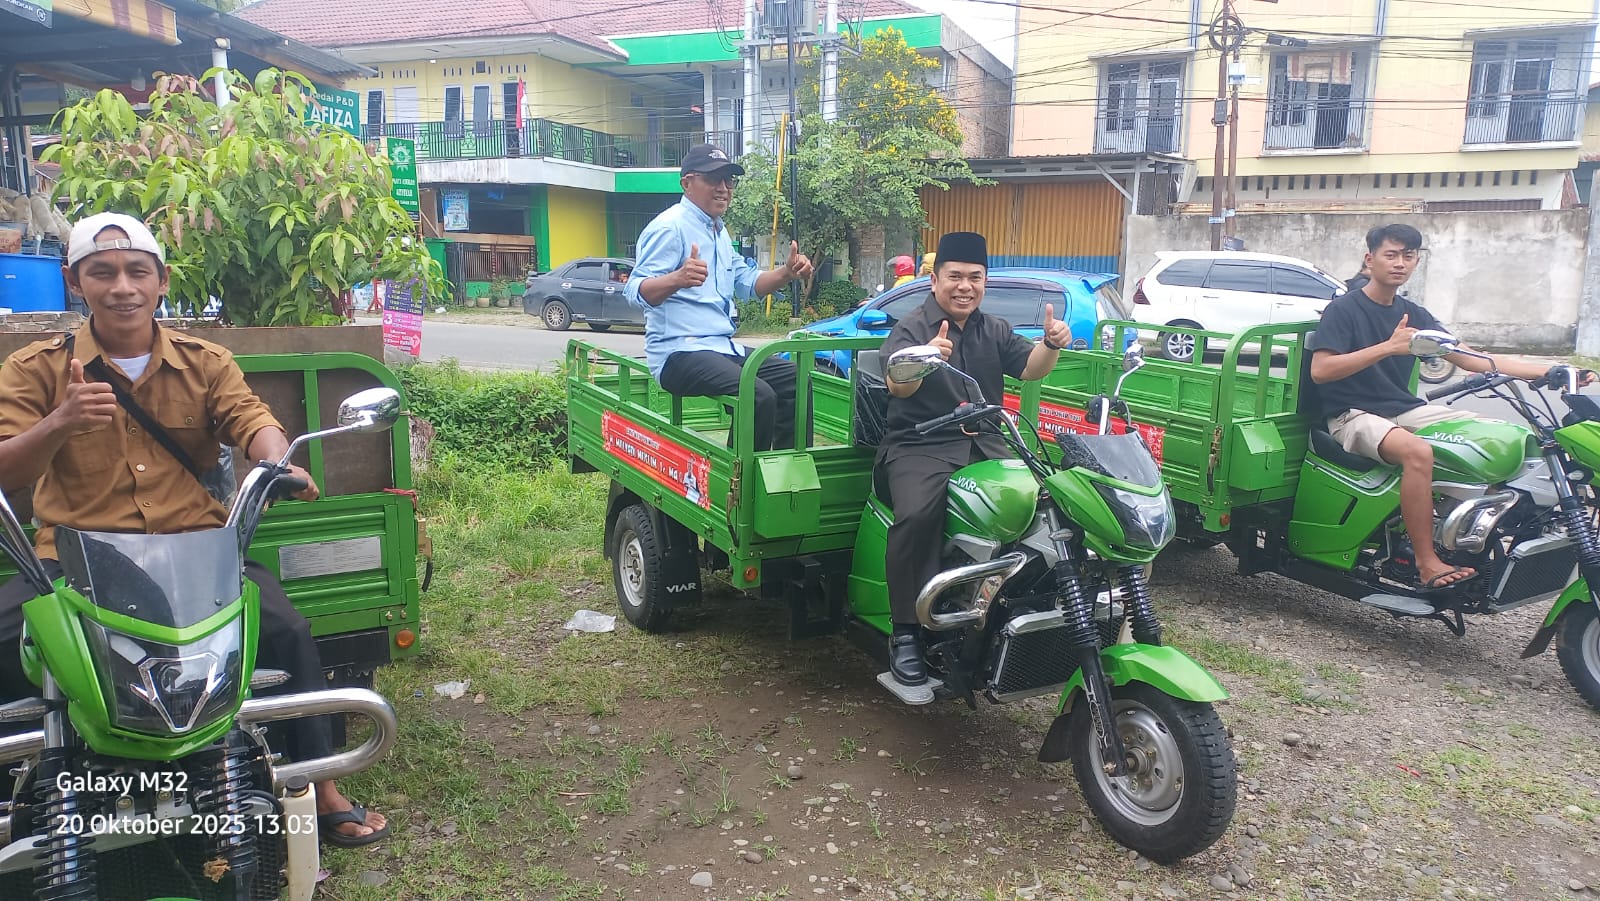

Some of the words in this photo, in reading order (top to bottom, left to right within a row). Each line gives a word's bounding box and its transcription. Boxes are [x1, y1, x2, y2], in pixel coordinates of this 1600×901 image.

[336, 95, 354, 107] P&D
[310, 104, 354, 128] AFIZA
[1434, 431, 1464, 443] VIAR
[957, 475, 977, 492] VIAR
[665, 582, 697, 593] VIAR
